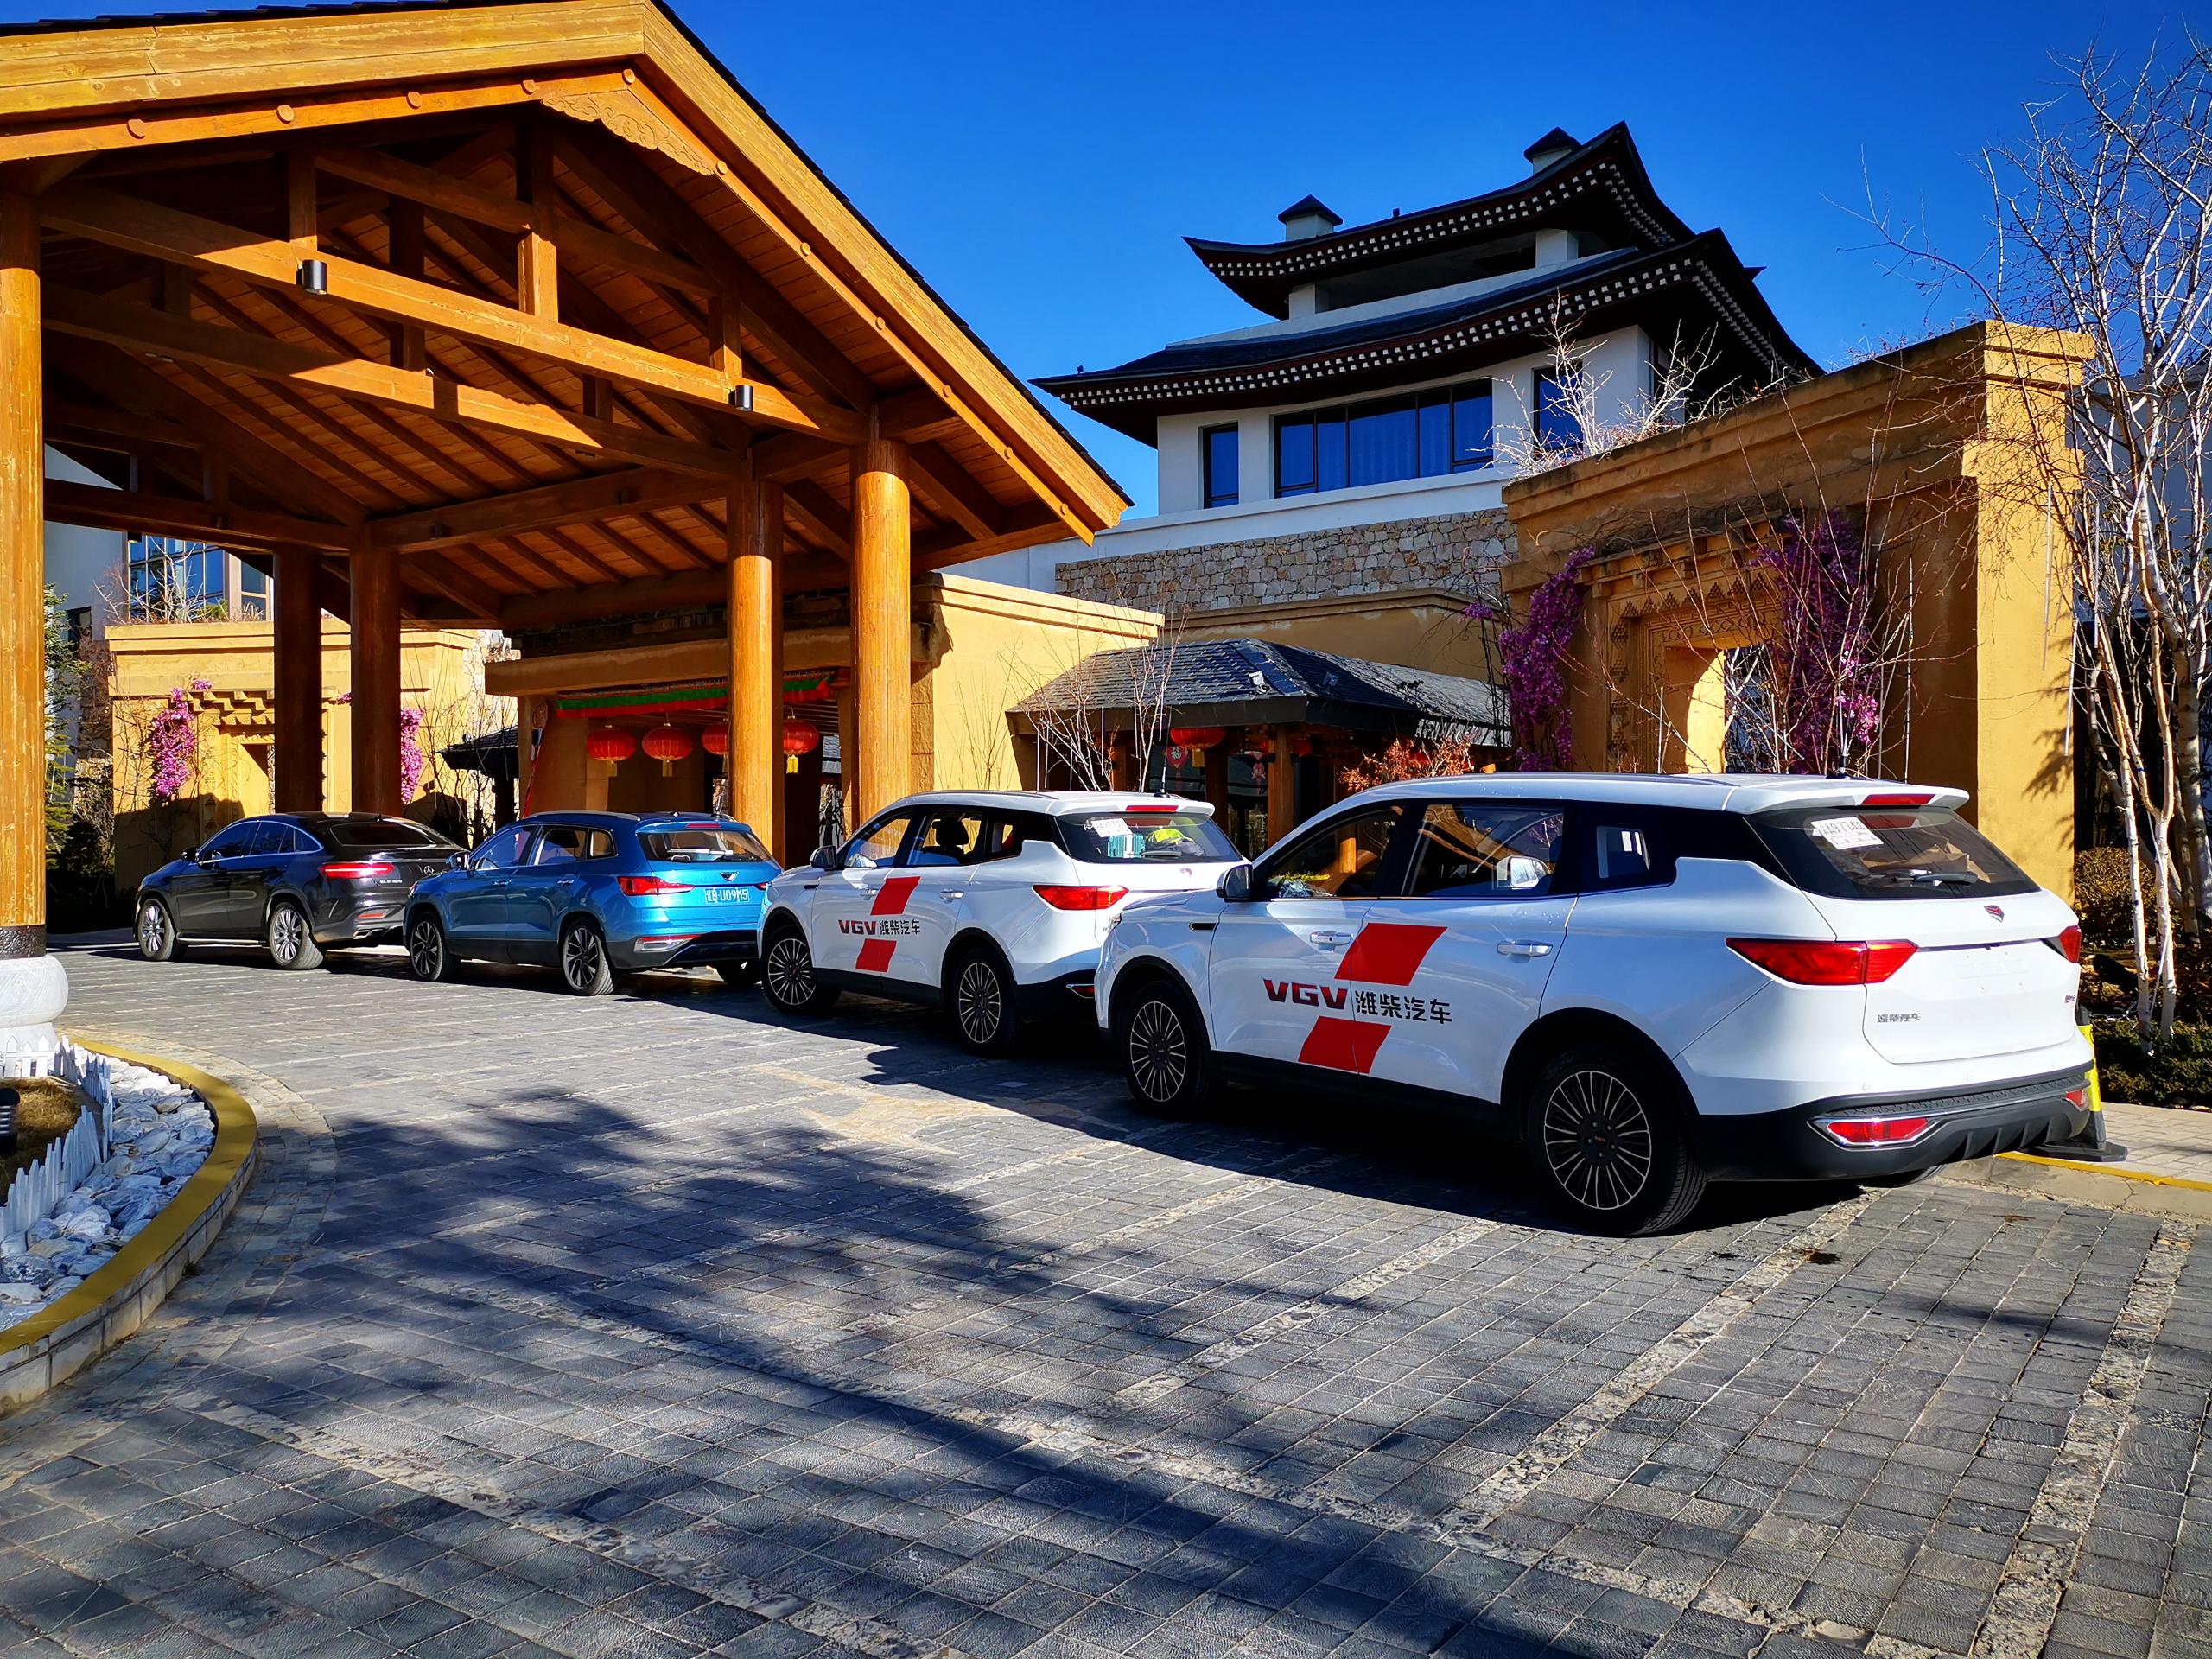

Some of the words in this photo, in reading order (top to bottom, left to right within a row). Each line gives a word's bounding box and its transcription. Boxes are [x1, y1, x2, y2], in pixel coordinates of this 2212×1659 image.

[838, 919, 876, 935] VGV
[879, 919, 921, 935] 潍柴汽车
[1262, 977, 1348, 1010] VGV
[1354, 989, 1452, 1024] 潍柴汽车
